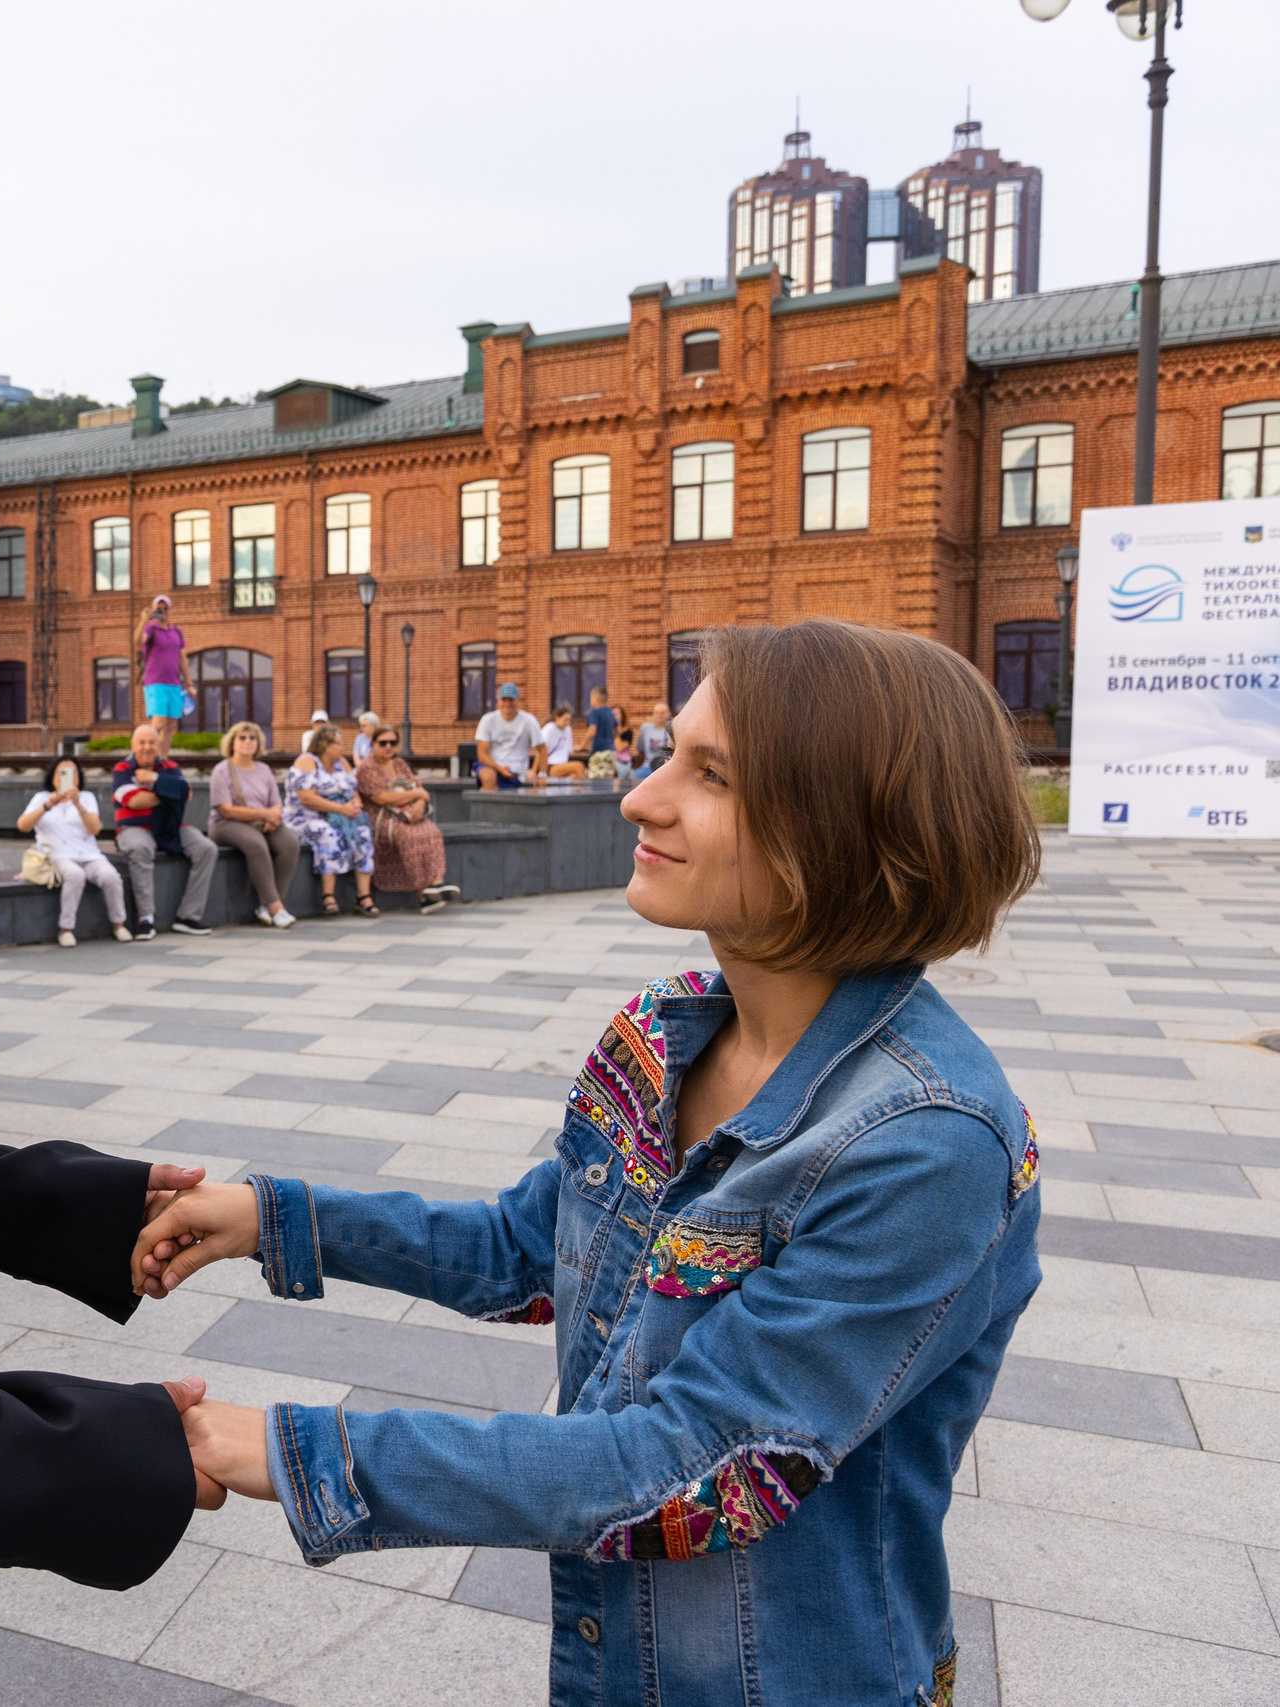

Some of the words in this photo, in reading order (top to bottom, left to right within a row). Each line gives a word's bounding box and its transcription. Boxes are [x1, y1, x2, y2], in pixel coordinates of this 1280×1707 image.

[1204, 565, 1280, 577] МЕЖДУН
[1108, 655, 1127, 668] 18
[1132, 653, 1206, 668] сентября
[1226, 652, 1246, 666] 11
[1107, 673, 1263, 693] ВЛАДИВОСТОК
[1103, 763, 1249, 776] PACIFICFEST.RU
[1206, 810, 1249, 827] ВТБ
